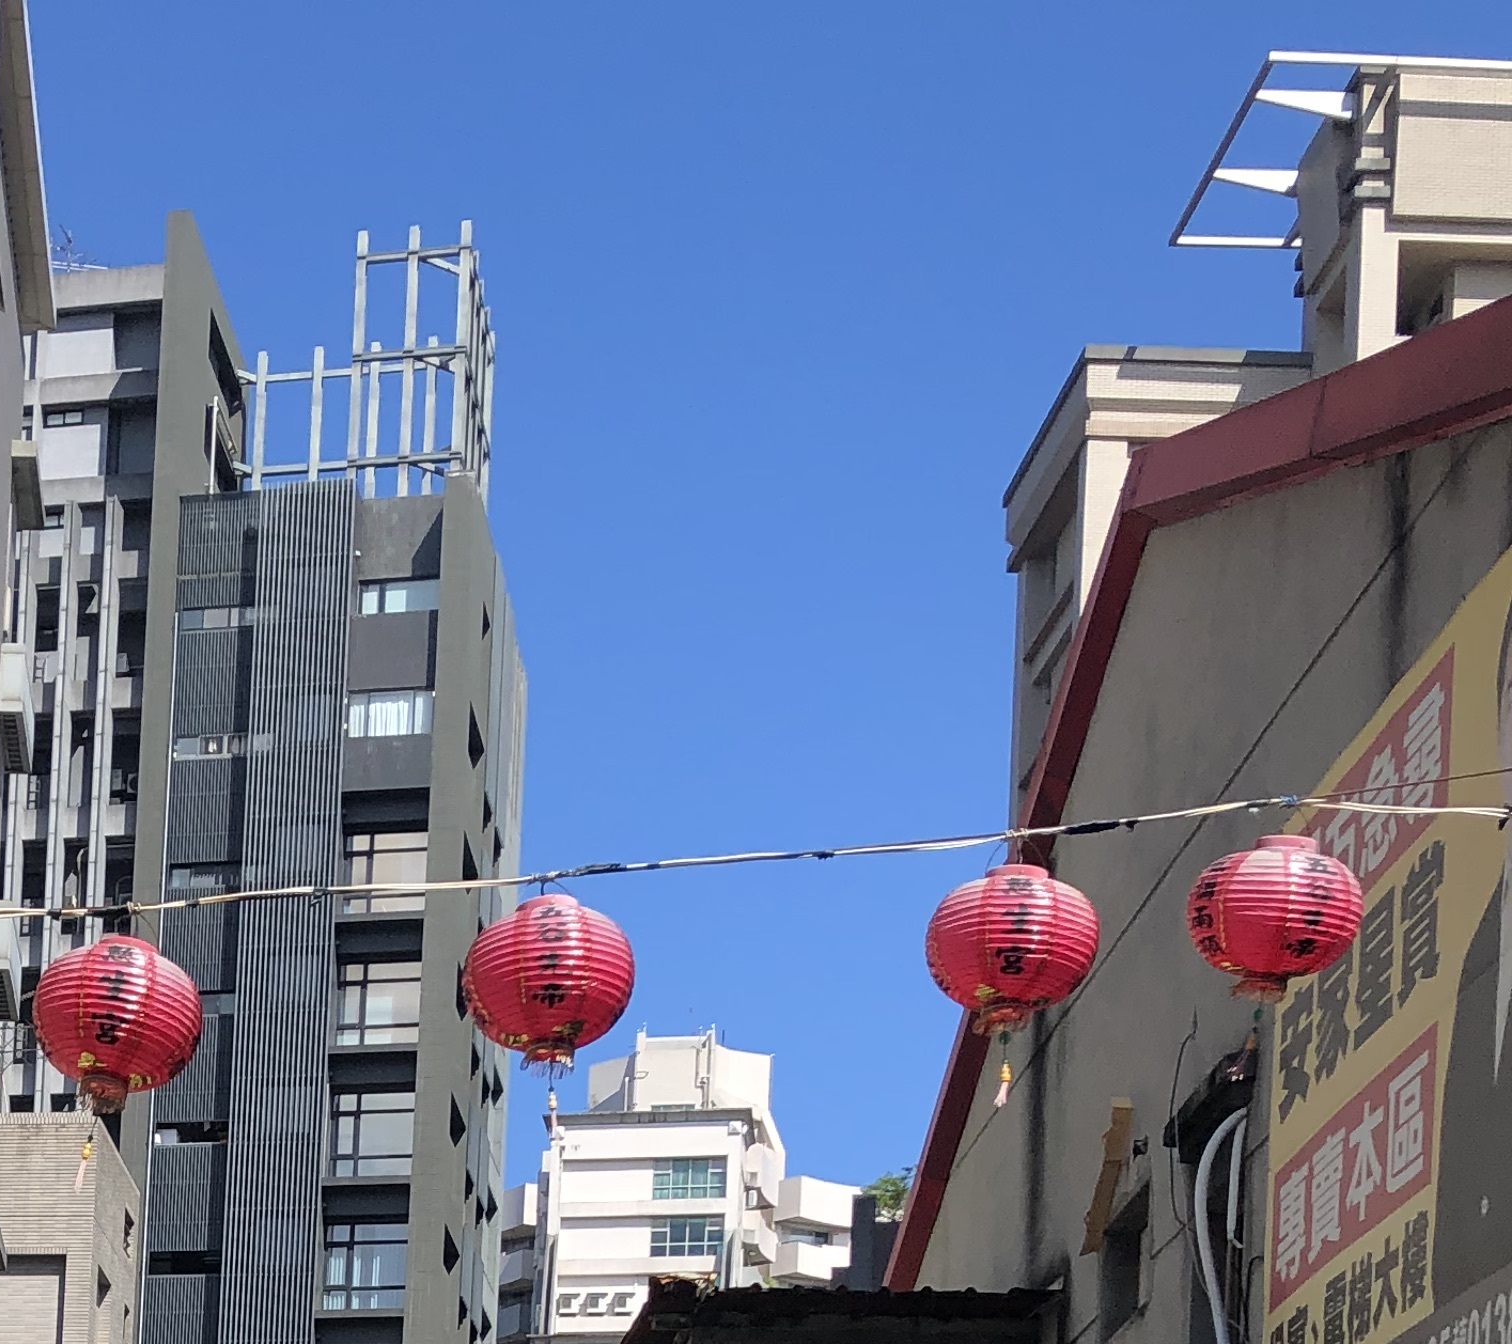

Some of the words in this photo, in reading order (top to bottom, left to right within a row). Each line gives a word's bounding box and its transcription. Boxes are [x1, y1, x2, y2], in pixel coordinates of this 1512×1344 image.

[1312, 682, 1446, 877] 方急尋
[1275, 1048, 1430, 1283] 專賣本區
